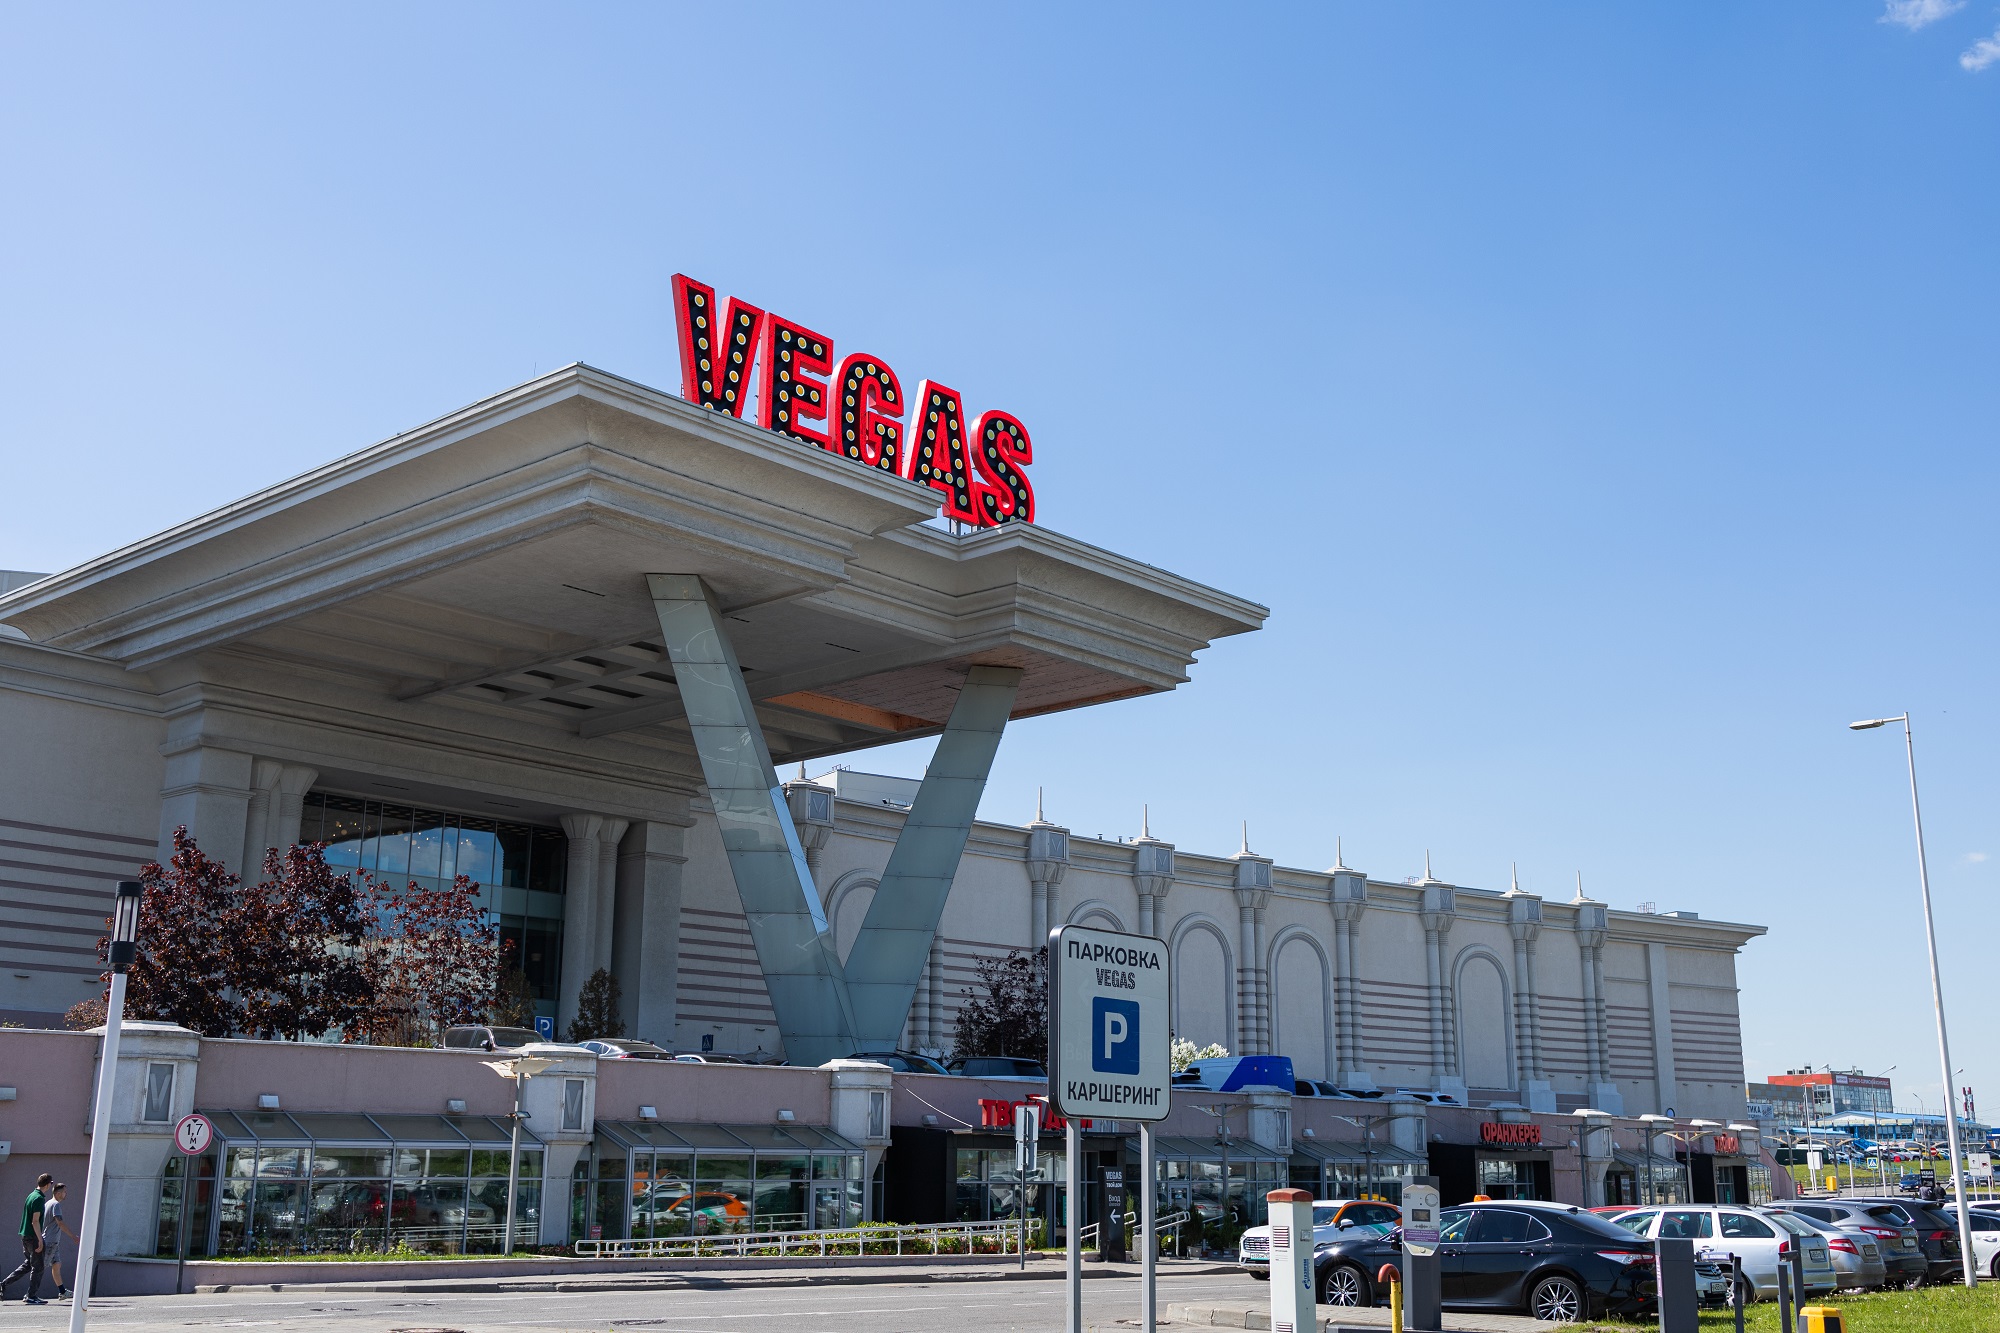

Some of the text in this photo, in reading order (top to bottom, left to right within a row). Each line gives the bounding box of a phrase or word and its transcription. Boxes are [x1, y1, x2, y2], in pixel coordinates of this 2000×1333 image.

[671, 273, 1035, 528] VEGAS
[1068, 940, 1161, 970] ПАРКОВКА
[1095, 967, 1136, 990] VEGAS
[1104, 1011, 1128, 1059] P
[1067, 1081, 1161, 1106] КАРШЕРИНГ
[186, 1123, 204, 1138] 1,7
[1481, 1122, 1542, 1143] ОРАНЖЕРЕЯ
[1105, 1171, 1122, 1180] VEGAS
[1108, 1194, 1121, 1203] Вход
